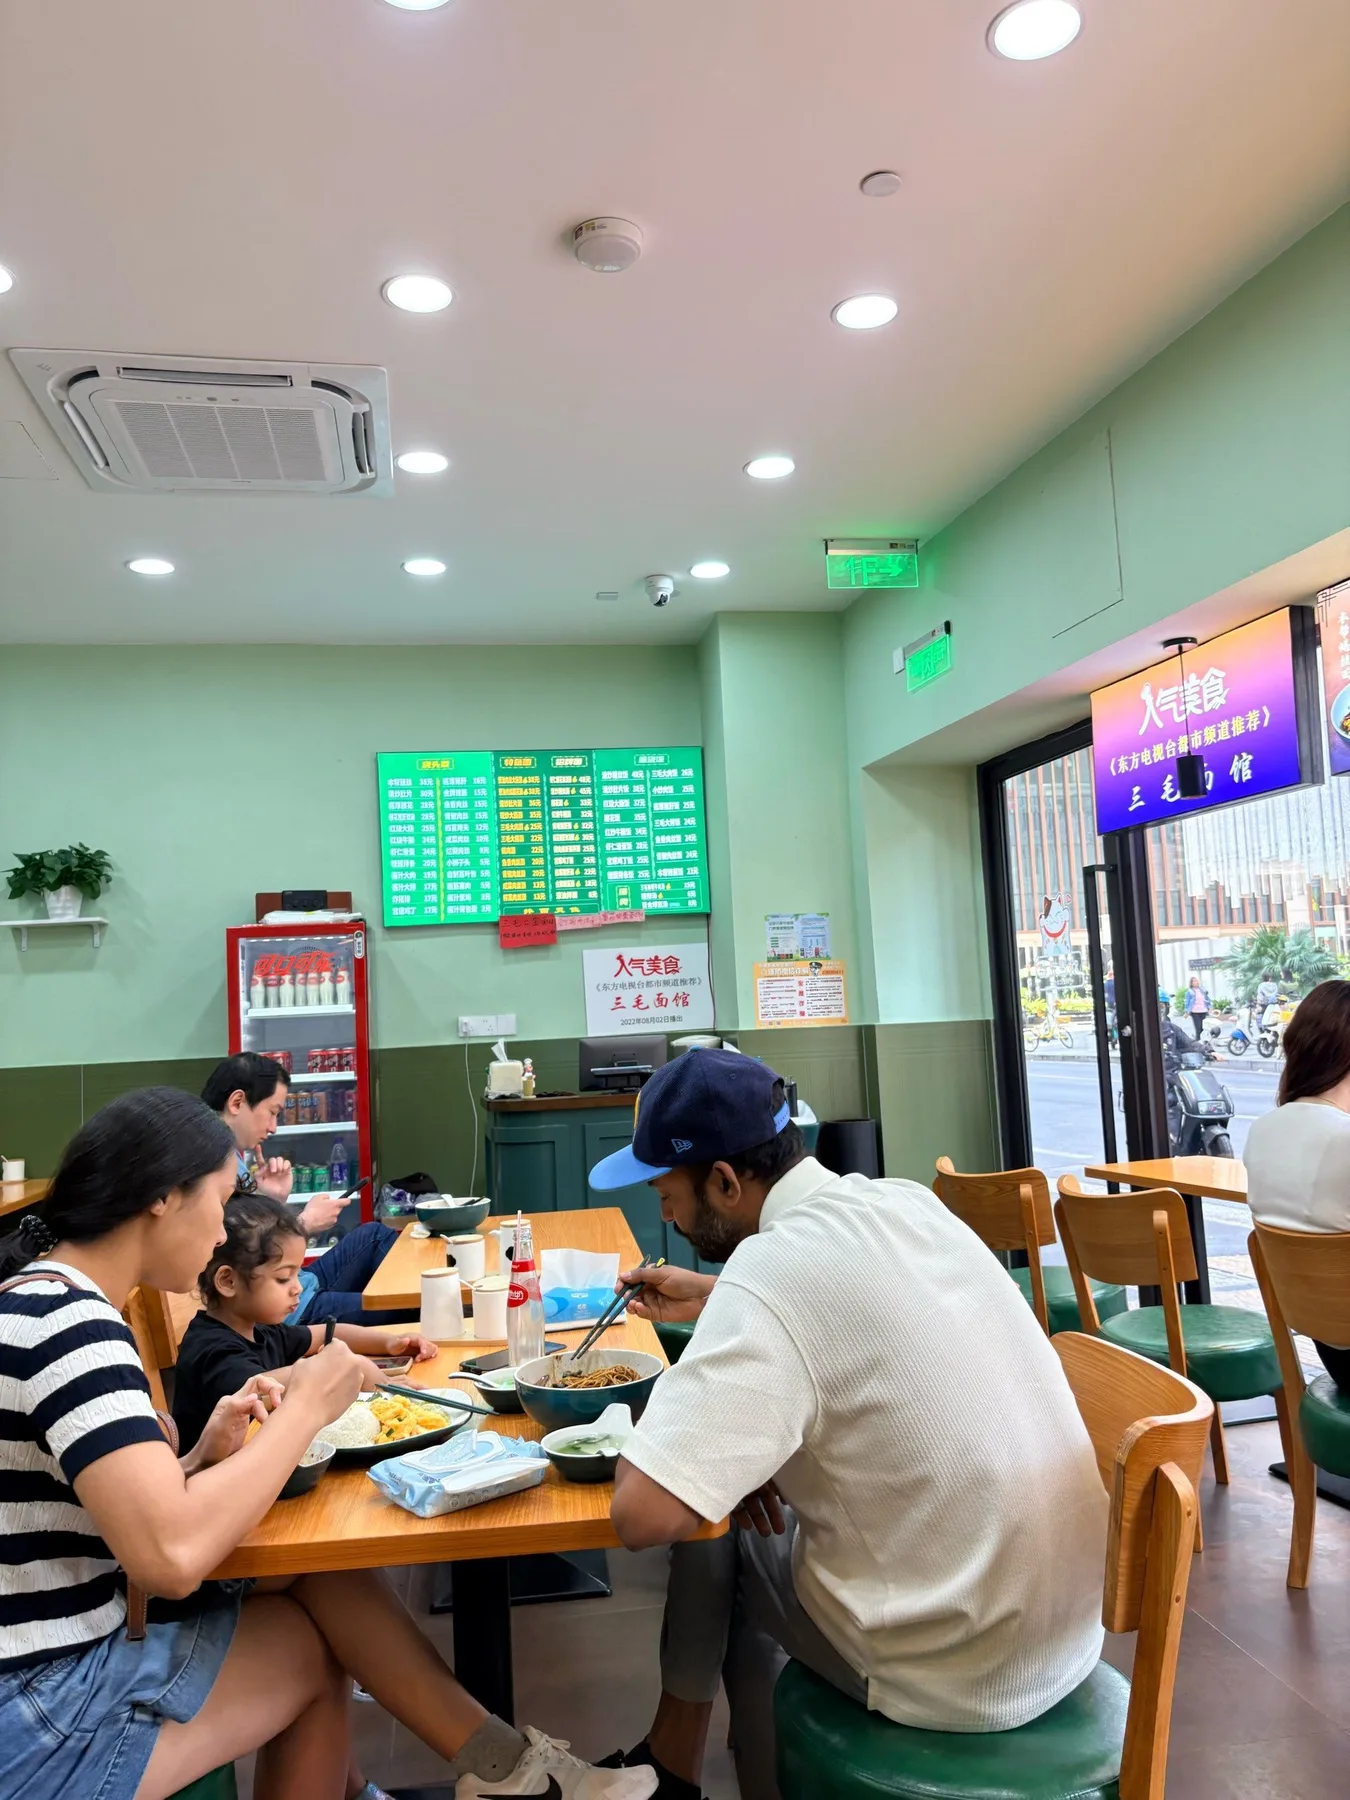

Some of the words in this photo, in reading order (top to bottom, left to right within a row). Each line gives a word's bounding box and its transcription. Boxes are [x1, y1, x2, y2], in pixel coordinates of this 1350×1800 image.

[1139, 667, 1232, 736] 人气美食
[614, 954, 683, 978] 人气美食
[596, 977, 703, 992] 《东方电视台都市频道推荐》
[610, 992, 690, 1011] 三毛面馆
